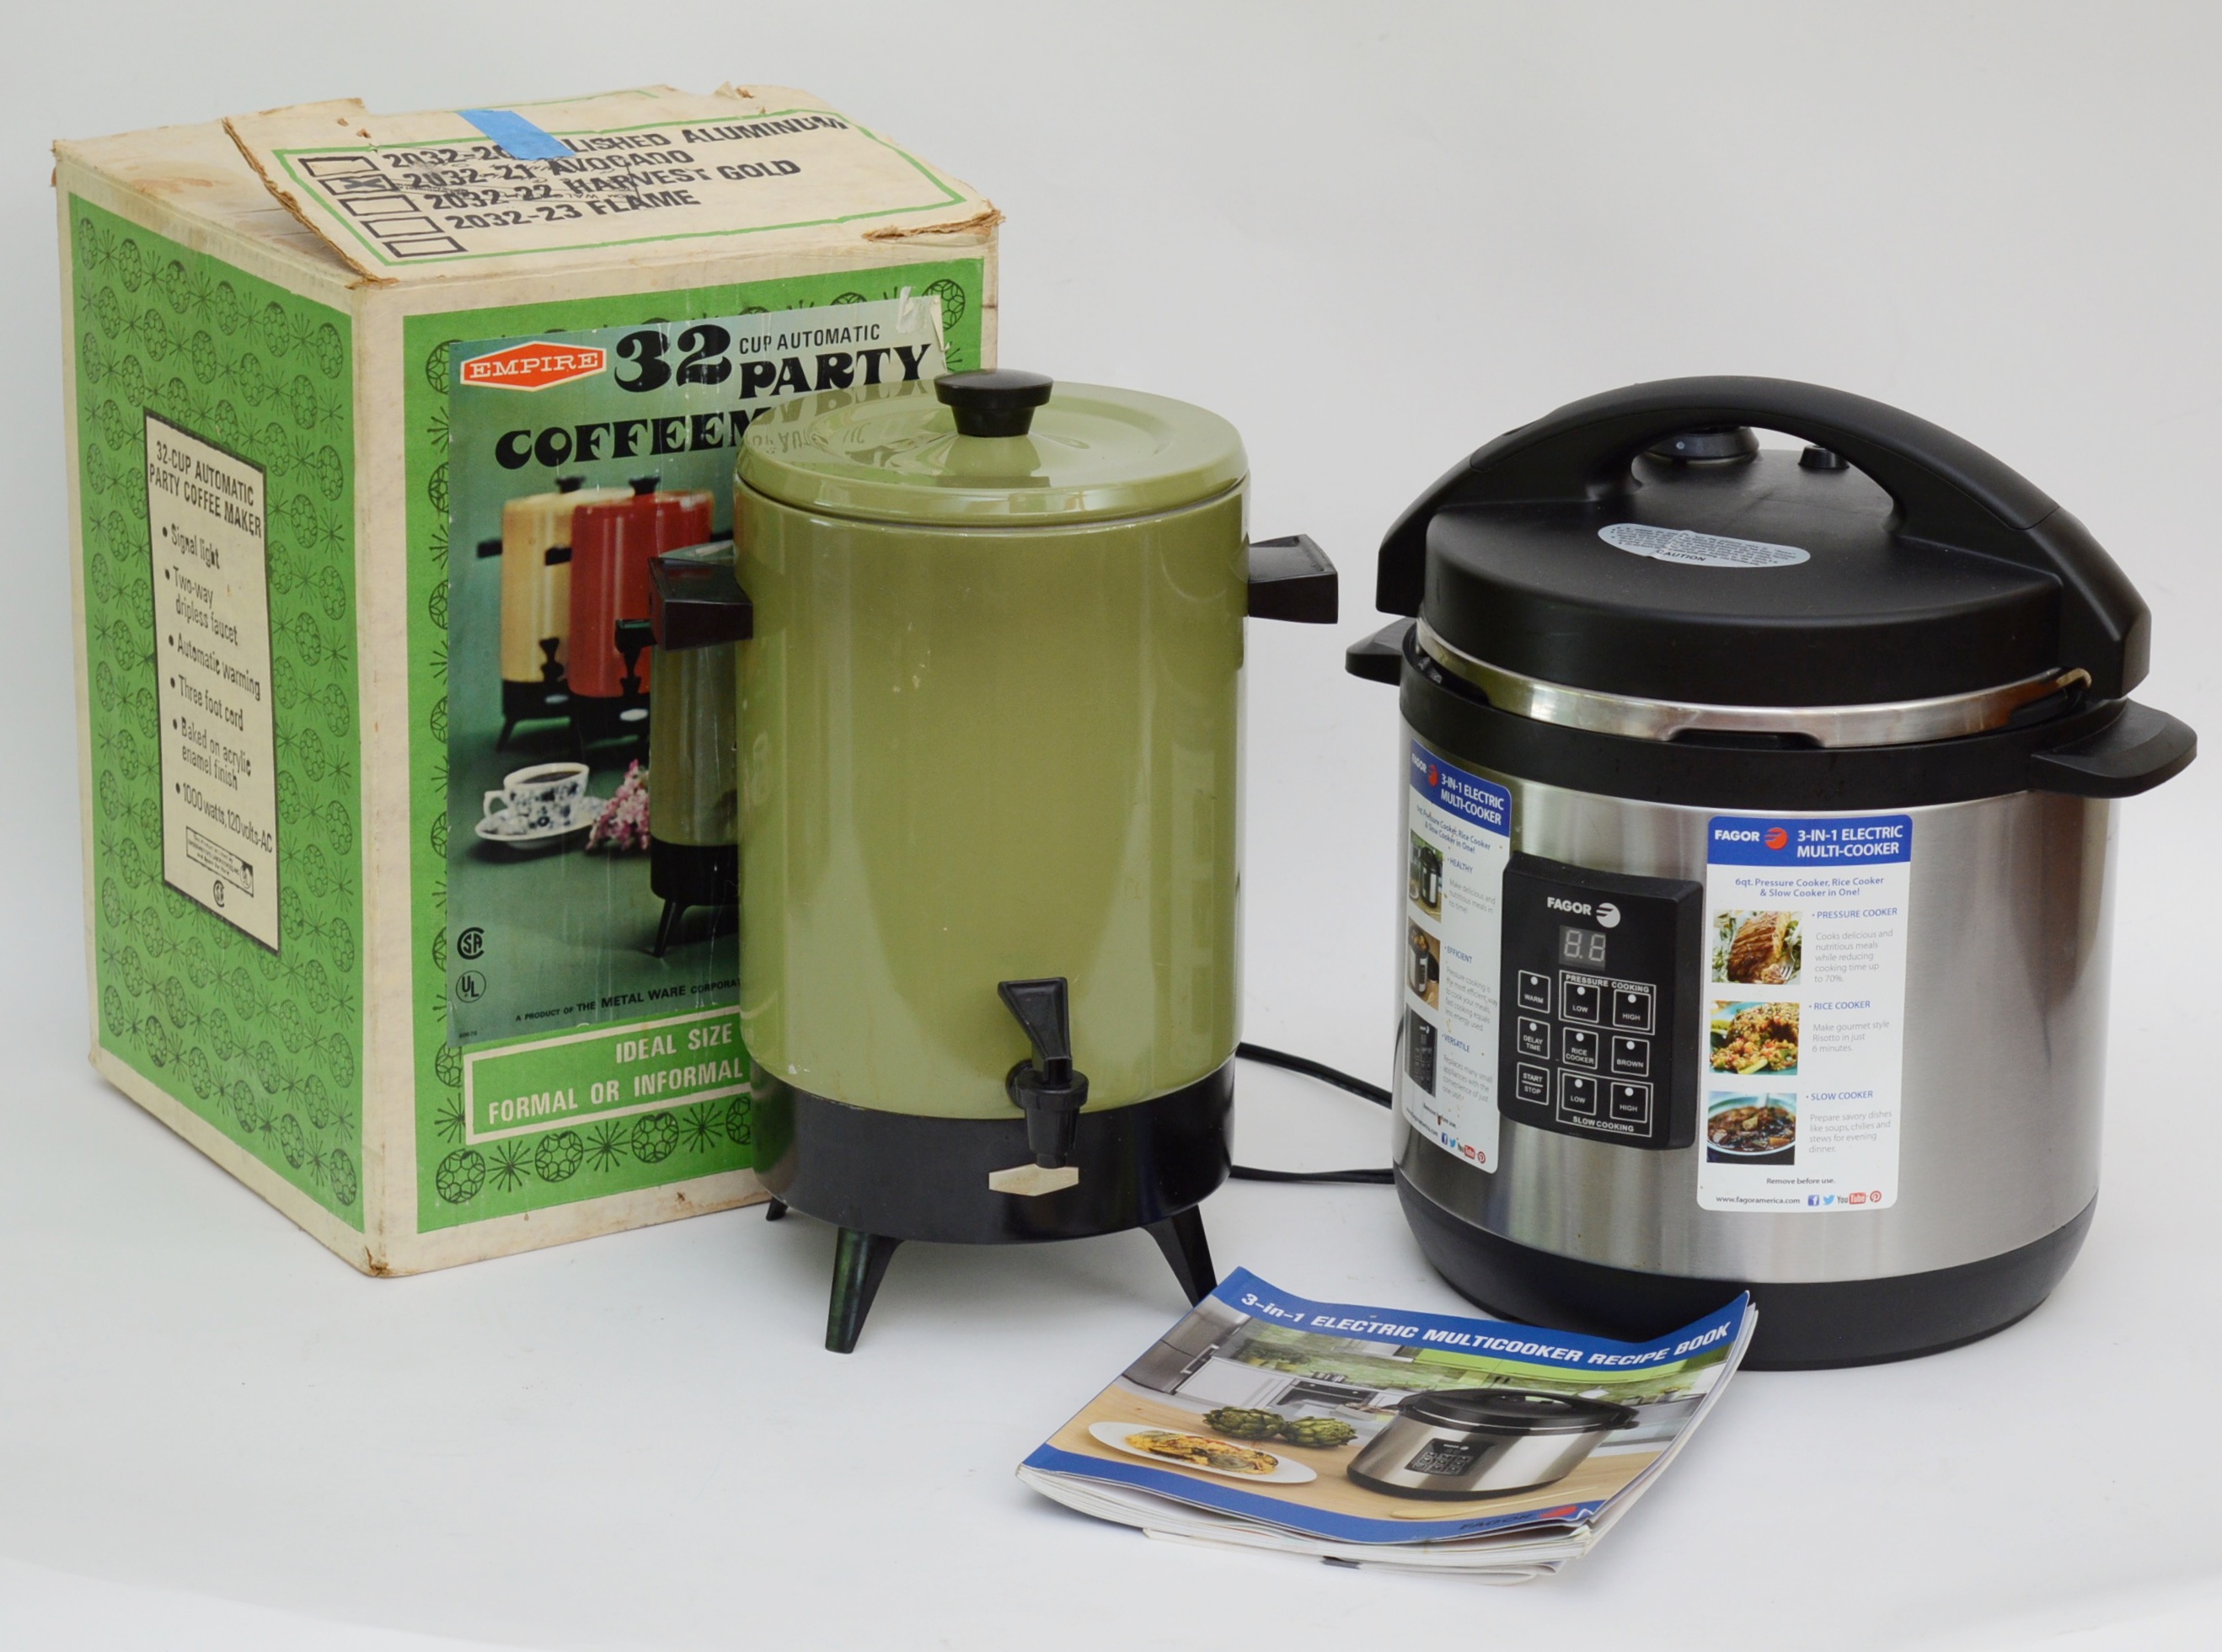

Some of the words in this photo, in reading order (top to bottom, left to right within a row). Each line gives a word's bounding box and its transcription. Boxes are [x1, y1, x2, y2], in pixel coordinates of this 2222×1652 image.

[563, 133, 671, 153] LISHED
[681, 115, 849, 143] ALUMINUM
[403, 164, 537, 187] 2032-21
[549, 150, 694, 176] AVOCADO
[424, 184, 558, 210] 2032-22
[565, 168, 712, 195] HARVEST
[717, 159, 801, 180] GOLD
[444, 204, 582, 229] 2032-23
[588, 189, 701, 216] FLAME
[469, 351, 599, 378] EMPIRE
[613, 323, 732, 393] 32
[738, 335, 772, 355] CUP
[778, 323, 881, 350] AUTOMATIC
[738, 343, 932, 399] PARTY
[495, 407, 772, 470] COFFEEM
[157, 441, 190, 475] 32-CUP
[195, 460, 254, 506] AUTOMATIC
[149, 463, 179, 497] PARTY
[184, 480, 221, 517] COFFEE
[224, 500, 261, 539] MAKER
[171, 523, 197, 554] Signal
[201, 537, 220, 569] light
[1657, 549, 1706, 562] CAUTION
[173, 566, 213, 610] Two-way
[175, 593, 209, 629] dripless
[211, 611, 238, 646] faucet
[177, 634, 221, 675] Automatic
[222, 663, 260, 701] warming
[179, 674, 202, 707] Three
[205, 690, 222, 719] foot
[225, 706, 244, 732] cord
[181, 716, 207, 749] Baked
[210, 739, 220, 756] on
[182, 744, 211, 775] enamel
[214, 763, 238, 791] finish
[182, 782, 202, 812] 1000
[1442, 773, 1462, 794] 3-IN-1
[1464, 784, 1504, 810] ELECTRIC
[1441, 789, 1502, 826] MULTI-COOKER
[1438, 829, 1455, 845] Cooker
[1462, 842, 1475, 853] One!
[1459, 830, 1470, 841] Rice
[1470, 836, 1491, 850] Cooker
[1714, 829, 1760, 842] FAGOR
[1797, 829, 1837, 842] 3-IN-1
[1841, 825, 1903, 841] ELECTRIC
[1797, 842, 1899, 858] MULTI-COOKER
[1449, 857, 1473, 874] HEALTHY
[1735, 878, 1753, 887] 6qt.
[1755, 878, 1794, 887] Pressure
[1796, 879, 1830, 887] Cooker,
[1832, 878, 1850, 886] Rice
[1853, 877, 1884, 885] Cooker
[1794, 889, 1825, 897] Cooker
[1828, 888, 1836, 896] in
[1547, 897, 1592, 916] FAGOR
[1817, 910, 1861, 919] PRESSURE
[1862, 907, 1898, 917] COOKER
[1816, 932, 1840, 941] Cooks
[1842, 930, 1877, 939] delicious
[1878, 929, 1893, 938] and
[1855, 941, 1878, 949] meals
[1447, 946, 1472, 963] EFFICIENT
[1815, 953, 1837, 961] while
[1839, 952, 1873, 962] reducing
[1815, 964, 1847, 973] cooking
[1849, 963, 1866, 971] time
[1869, 963, 1879, 971] up
[1566, 974, 1609, 987] PRESSURE
[1611, 981, 1650, 993] COOKING
[1814, 975, 1823, 983] to
[1825, 974, 1844, 983] 70%.
[524, 1009, 560, 1020] PRODUCT
[563, 1006, 574, 1015] OF
[576, 1001, 597, 1013] THE
[601, 993, 644, 1008] METAL
[648, 986, 686, 1001] WARE
[690, 978, 740, 994] CORPORAT
[1524, 993, 1544, 1004] WARM
[1814, 1002, 1833, 1010] RICE
[1834, 1000, 1871, 1009] COOKER
[1572, 1005, 1588, 1013] LOW
[1622, 1013, 1641, 1021] HIGH
[1813, 1024, 1834, 1032] Make
[1837, 1022, 1870, 1033] gourmet
[1872, 1020, 1889, 1030] style
[616, 1035, 677, 1064] IDEAL
[688, 1023, 732, 1051] SIZE
[1444, 1034, 1470, 1053] VERSATILE
[1523, 1035, 1543, 1046] DELAY
[1812, 1034, 1840, 1042] Risotto
[1842, 1033, 1850, 1041] in
[1850, 1033, 1865, 1043] just
[1526, 1042, 1541, 1051] TIME
[1571, 1047, 1588, 1056] RICE
[1820, 1044, 1853, 1052] minutes.
[1566, 1053, 1594, 1065] COOKER
[1616, 1058, 1644, 1068] BROWN
[1523, 1072, 1543, 1083] START
[488, 1088, 578, 1124] FORMAL
[591, 1080, 619, 1105] OR
[634, 1058, 743, 1097] INFORMAL
[1524, 1085, 1541, 1095] STOP
[1811, 1093, 1836, 1101] SLOW
[1838, 1090, 1873, 1099] COOKER
[1571, 1095, 1586, 1104] LOW
[1620, 1104, 1638, 1112] HIGH
[1572, 1115, 1596, 1126] SLOW
[1596, 1120, 1635, 1133] COOKING
[1810, 1114, 1839, 1123] Prepare
[1842, 1112, 1866, 1121] savory
[1869, 1110, 1892, 1119] dishes
[1810, 1124, 1823, 1132] like
[1825, 1125, 1850, 1133] soups,
[1851, 1122, 1874, 1131] chilies
[1810, 1135, 1832, 1143] stews
[1834, 1133, 1845, 1141] for
[1846, 1133, 1877, 1142] evening
[1809, 1145, 1836, 1153] dinner.
[1716, 1195, 1801, 1206] www.fagoramerica.com
[1240, 1292, 1304, 1323] 3-in-1
[1311, 1315, 1419, 1339] ELECTRIC
[1426, 1329, 1583, 1363] MULTICOOKER
[1588, 1347, 1668, 1366] RECIPE
[1673, 1322, 1732, 1360] BOOK
